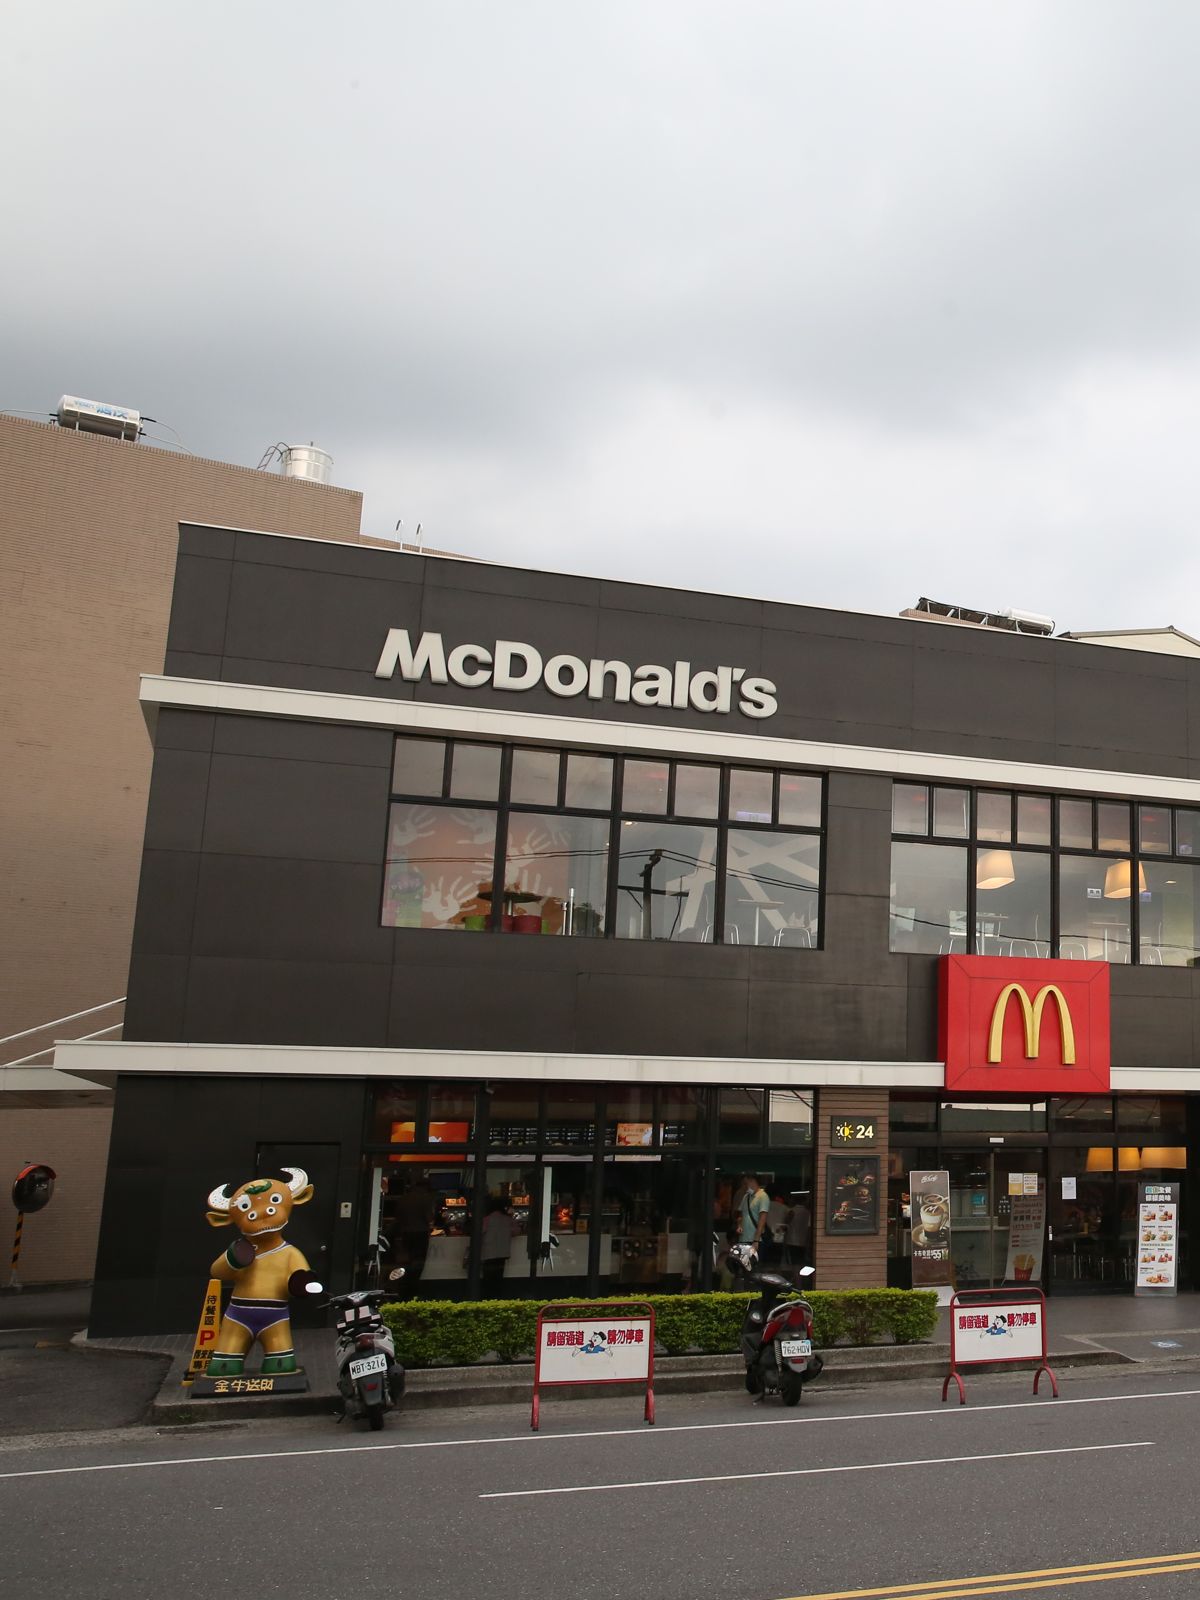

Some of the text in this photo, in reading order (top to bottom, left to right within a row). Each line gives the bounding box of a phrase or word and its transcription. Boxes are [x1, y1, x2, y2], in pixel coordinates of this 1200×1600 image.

[374, 627, 779, 719] McDonald's
[856, 1125, 874, 1139] 24
[200, 1330, 216, 1346] P
